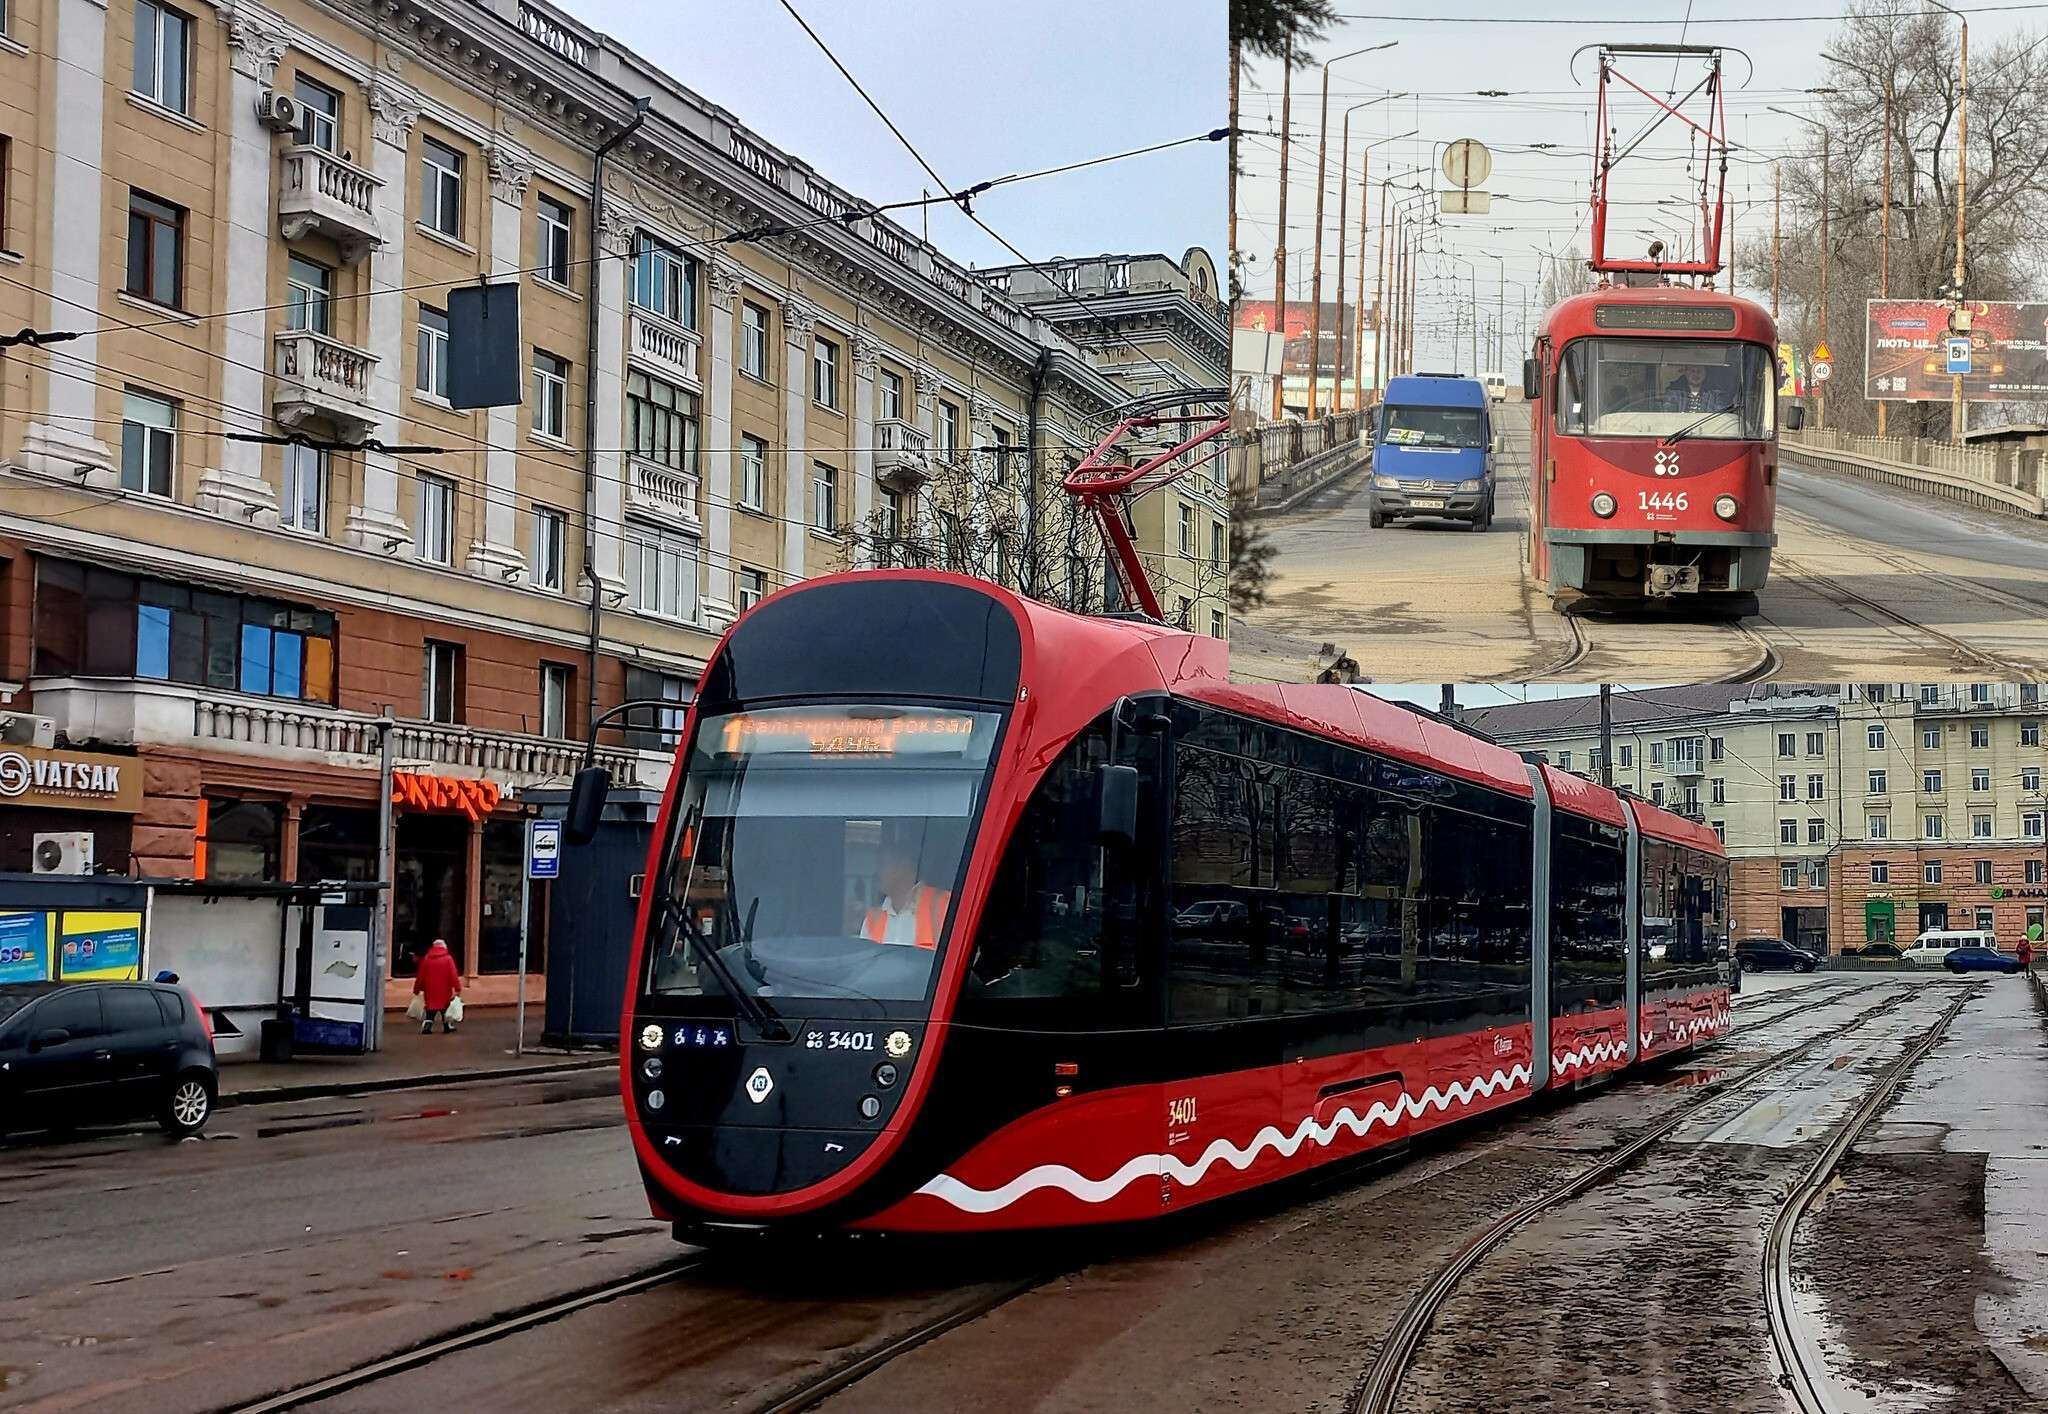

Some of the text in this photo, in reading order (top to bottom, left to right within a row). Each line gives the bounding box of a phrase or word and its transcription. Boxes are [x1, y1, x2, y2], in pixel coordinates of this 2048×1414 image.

[1876, 339, 1911, 348] ЛЮТЬ
[1816, 366, 1828, 375] 40
[1638, 491, 1689, 511] 1446
[723, 713, 749, 752] 1
[33, 760, 121, 793] VATSAK
[827, 1031, 875, 1051] 3401
[1168, 1096, 1197, 1127] 3401
